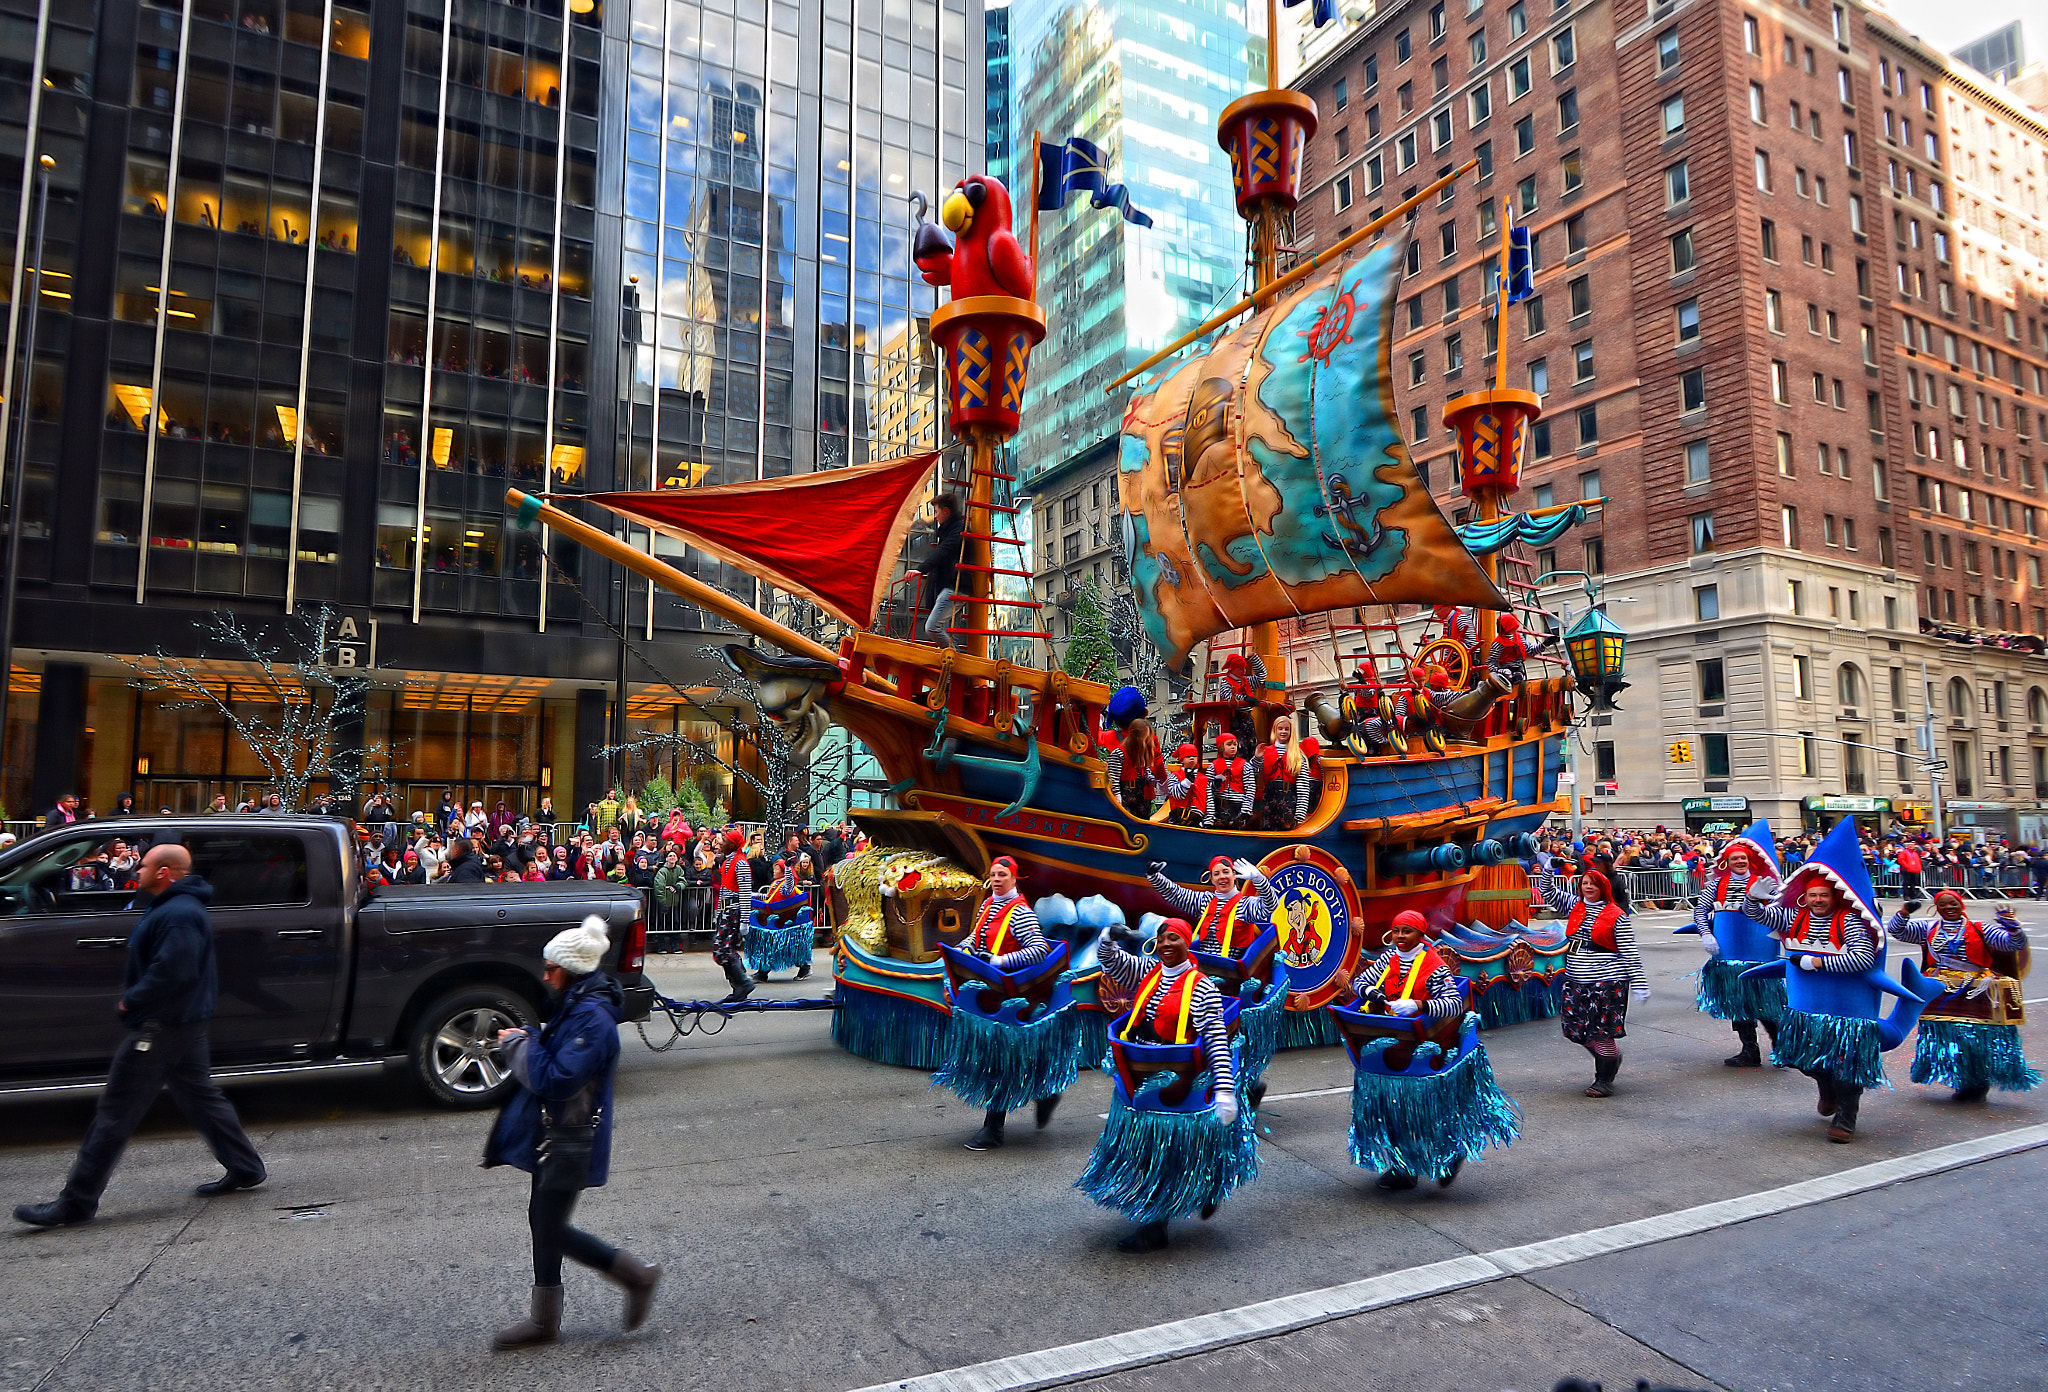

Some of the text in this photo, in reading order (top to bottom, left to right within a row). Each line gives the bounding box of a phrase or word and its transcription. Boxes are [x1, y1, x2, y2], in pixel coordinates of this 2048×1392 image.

[337, 616, 359, 638] A
[338, 647, 357, 667] B
[964, 806, 1086, 838] TREASURE
